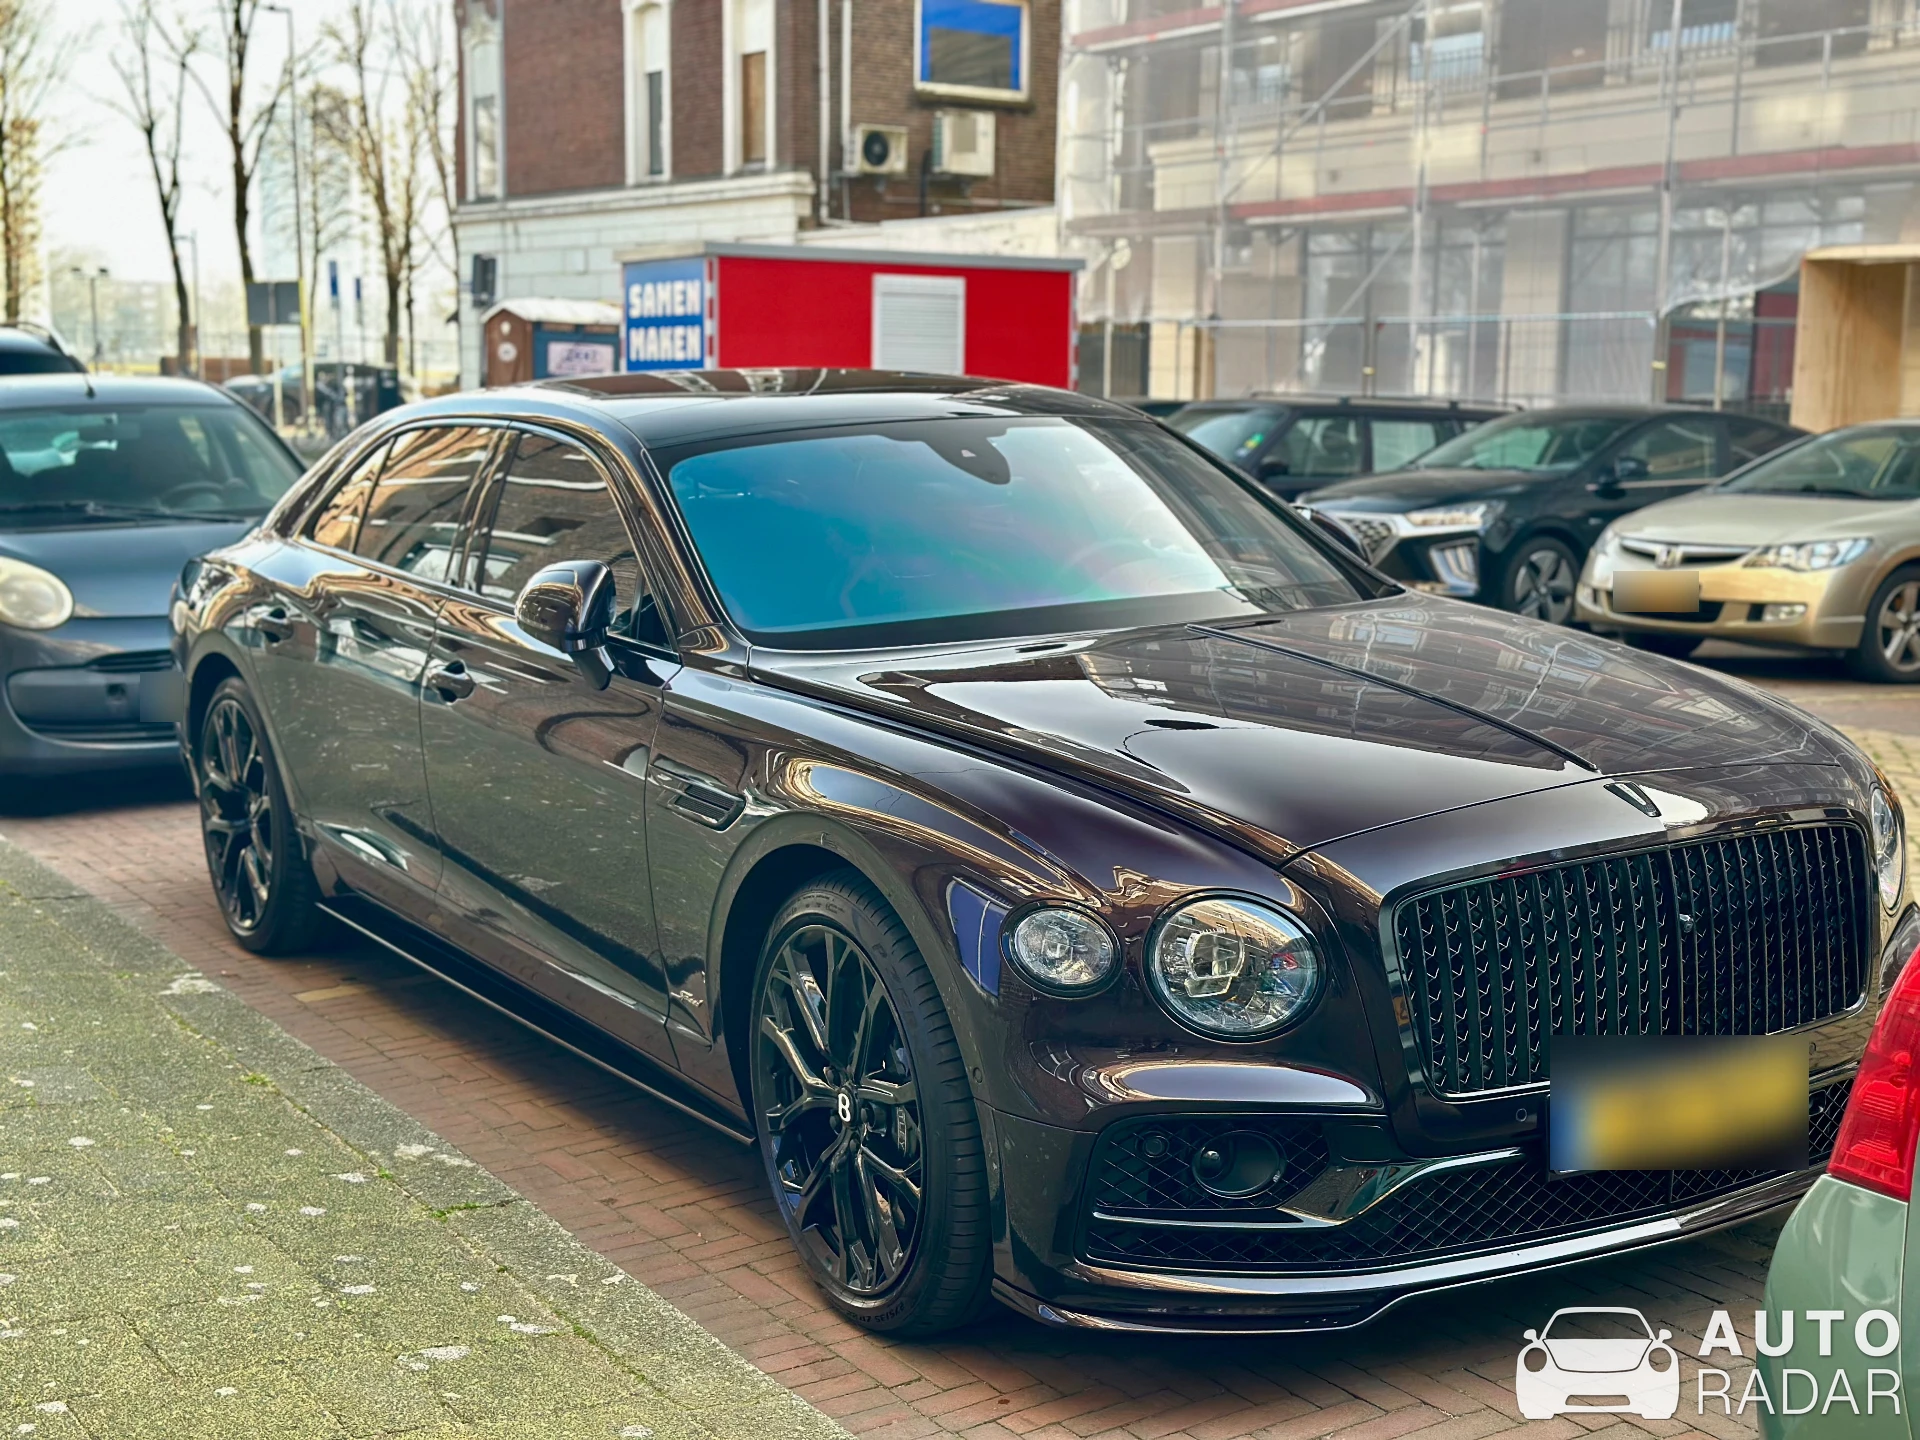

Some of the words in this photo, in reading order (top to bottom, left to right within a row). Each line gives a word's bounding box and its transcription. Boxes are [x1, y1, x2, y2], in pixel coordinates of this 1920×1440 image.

[628, 280, 701, 319] SAMEN
[628, 325, 701, 362] MAKEN
[838, 1093, 851, 1122] B
